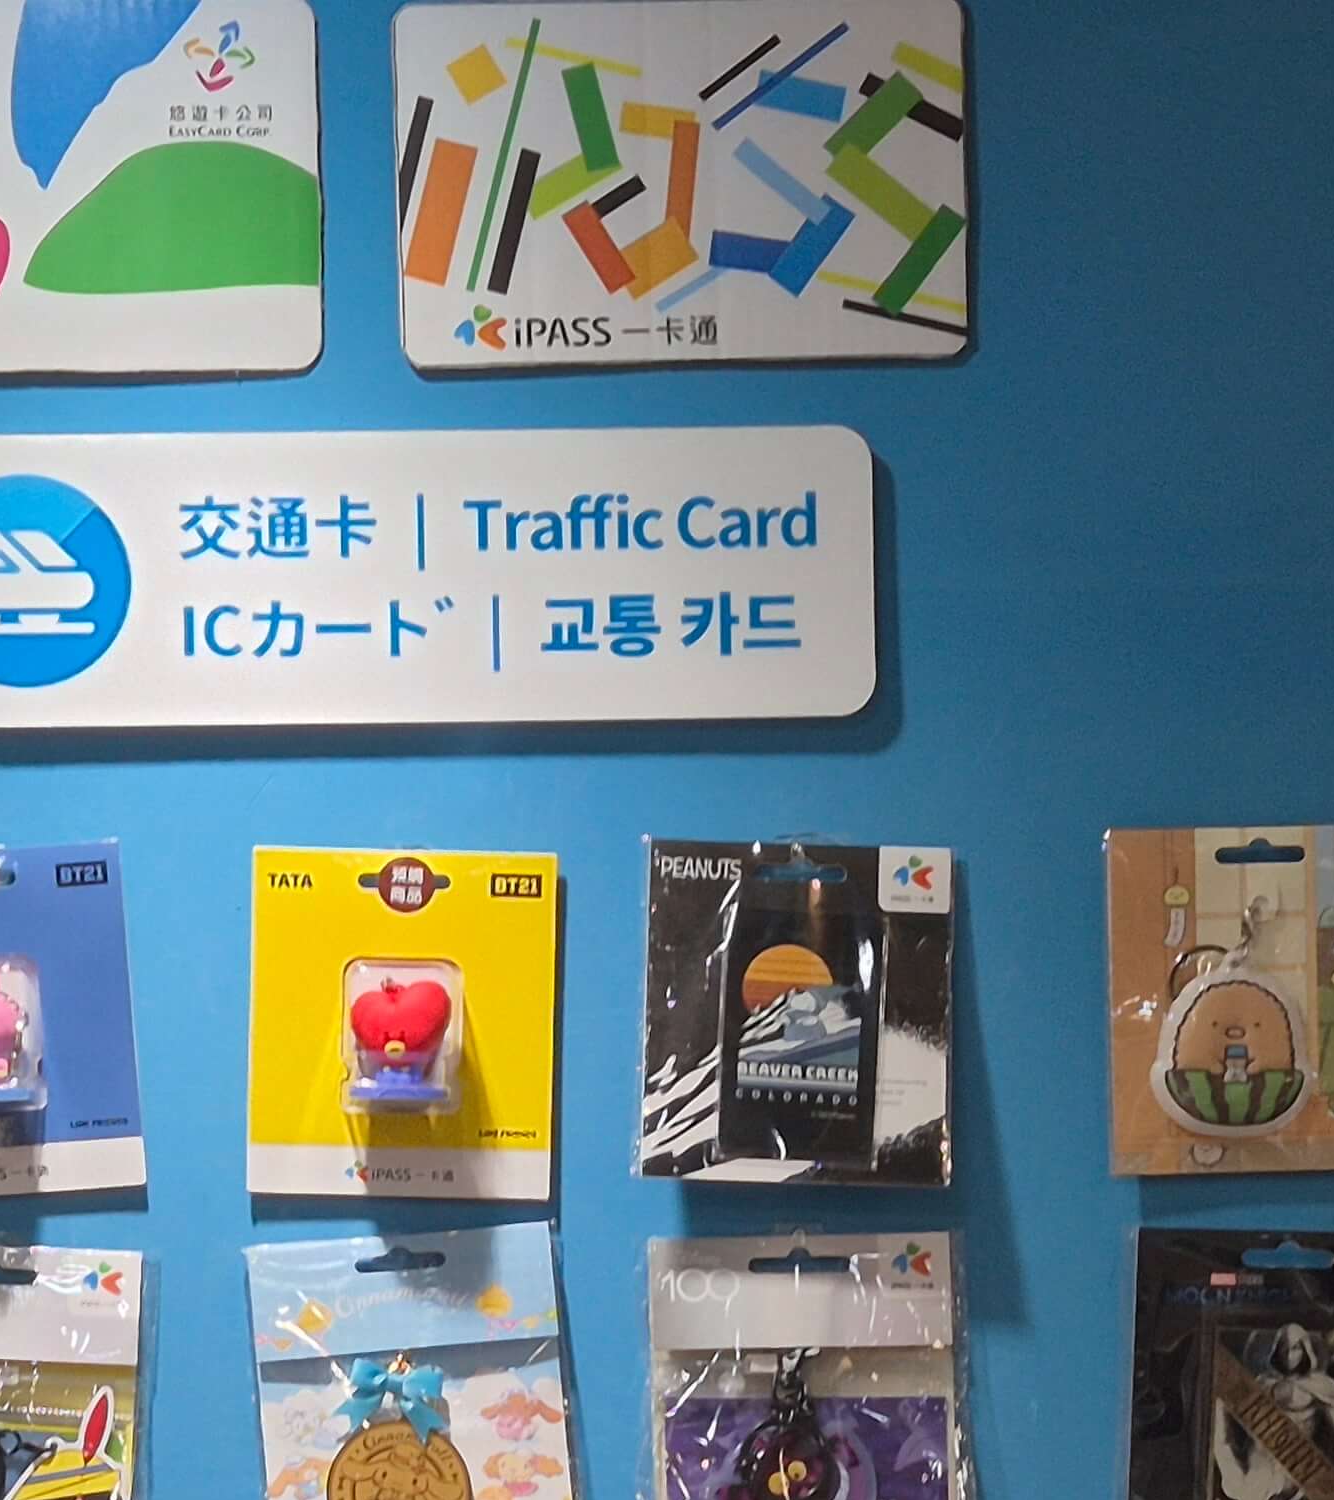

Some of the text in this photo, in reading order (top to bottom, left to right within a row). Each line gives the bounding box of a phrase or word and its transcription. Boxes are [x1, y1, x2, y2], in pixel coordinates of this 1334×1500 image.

[514, 316, 612, 348] iPASS
[622, 315, 718, 346] 一卡通
[178, 494, 377, 561] 交通卡
[463, 490, 819, 552] Traffic Card
[182, 597, 456, 659] ICカード
[541, 590, 802, 659] 교통 카드
[267, 872, 313, 890] TATA
[660, 855, 742, 881] PEANUTS
